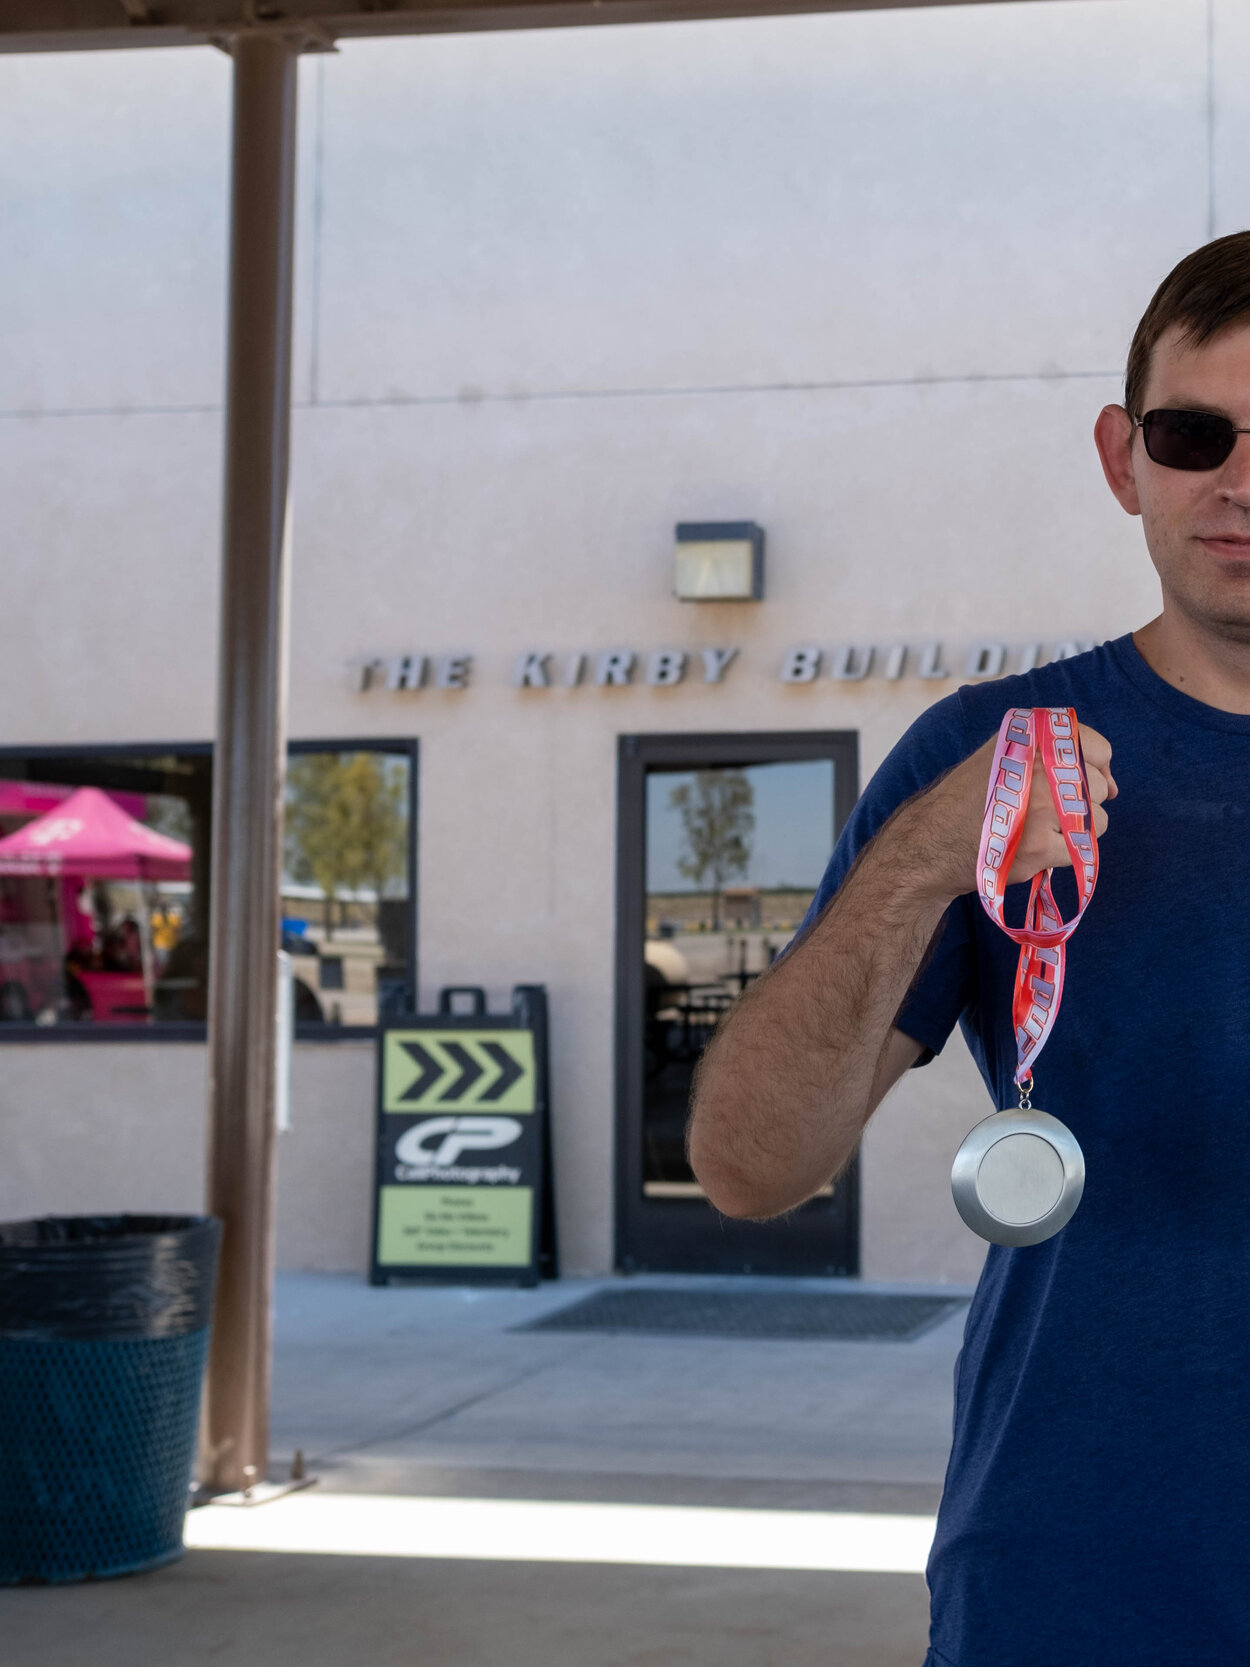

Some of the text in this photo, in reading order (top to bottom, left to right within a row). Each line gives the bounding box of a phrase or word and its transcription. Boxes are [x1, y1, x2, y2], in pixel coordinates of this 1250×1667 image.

[354, 653, 474, 692] THE
[513, 647, 740, 690] KIRBY
[1047, 707, 1087, 815] Plac
[394, 1115, 523, 1167] CP
